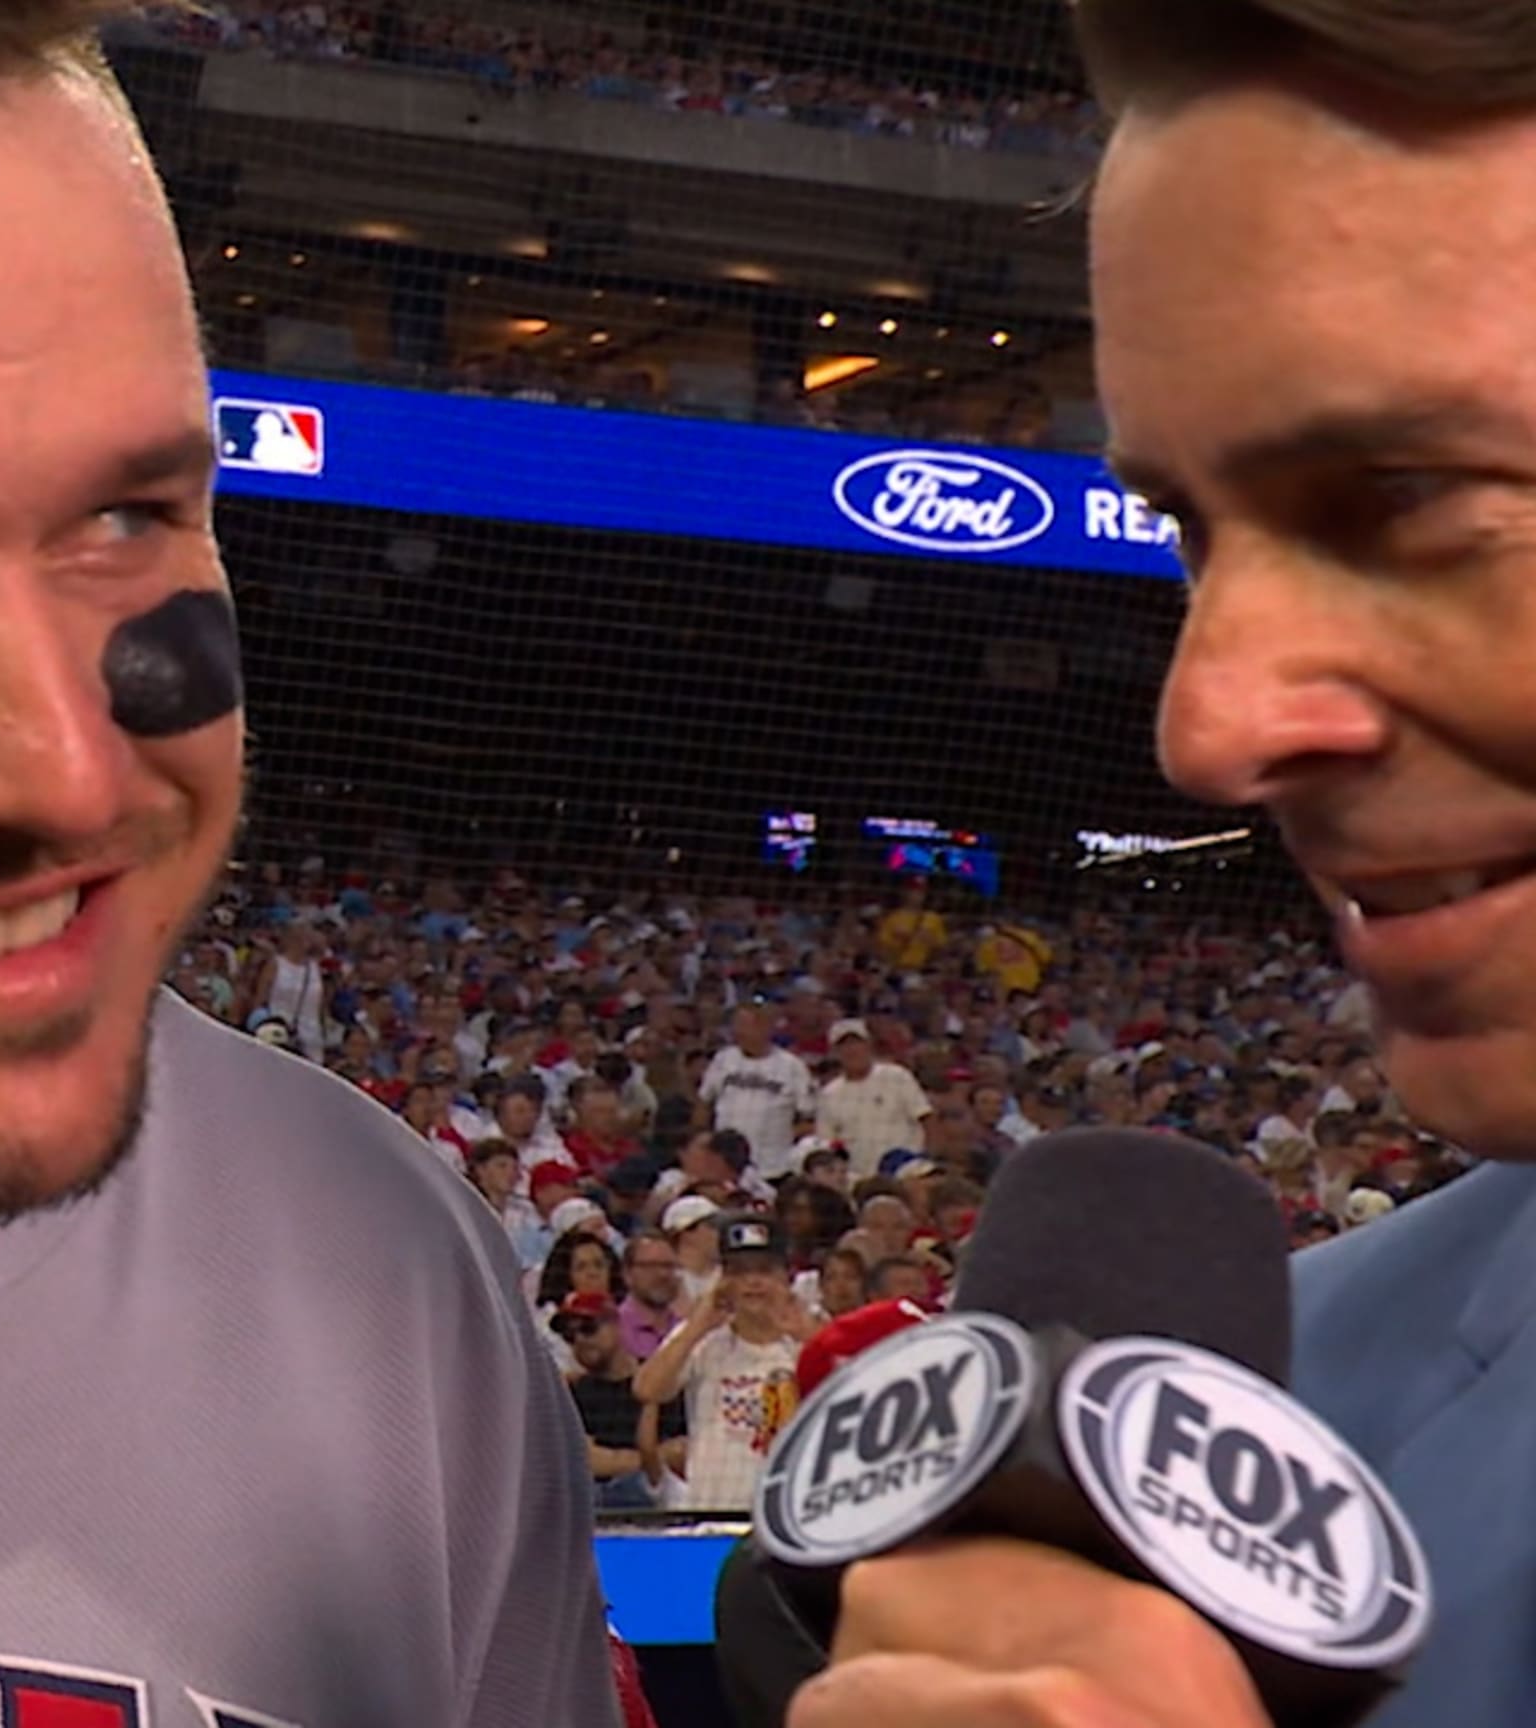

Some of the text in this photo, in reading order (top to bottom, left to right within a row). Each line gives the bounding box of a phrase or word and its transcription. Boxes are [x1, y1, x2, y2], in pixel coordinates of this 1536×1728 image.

[873, 462, 1015, 537] Ford
[801, 1441, 960, 1526] SPORTS
[811, 1352, 975, 1488] FOX
[1146, 1379, 1356, 1583] FOX
[1135, 1474, 1351, 1623] SPORTS
